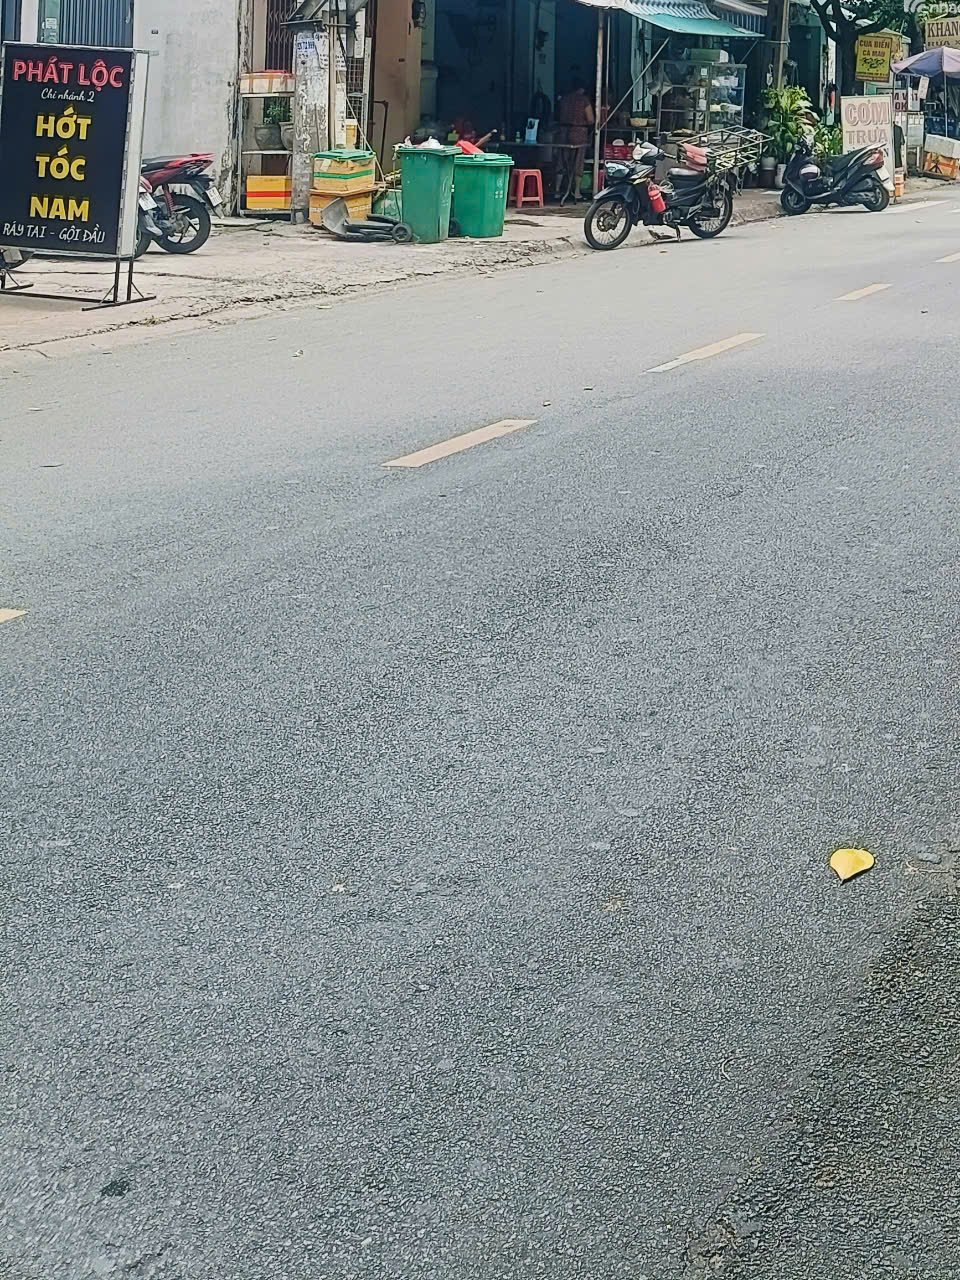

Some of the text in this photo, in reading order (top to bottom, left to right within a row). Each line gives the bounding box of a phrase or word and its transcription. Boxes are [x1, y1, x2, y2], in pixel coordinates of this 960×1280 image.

[12, 55, 125, 92] PHÁT LỘC
[41, 87, 95, 102] Chi nhánh 2
[36, 105, 92, 140] HỚT
[844, 99, 890, 126] CƠM
[846, 127, 888, 145] TRƯA
[35, 146, 86, 181] TÓC
[29, 194, 90, 222] NAM
[26, 224, 47, 238] TAI
[58, 223, 82, 243] GỘI
[81, 222, 106, 243] ĐẦU
